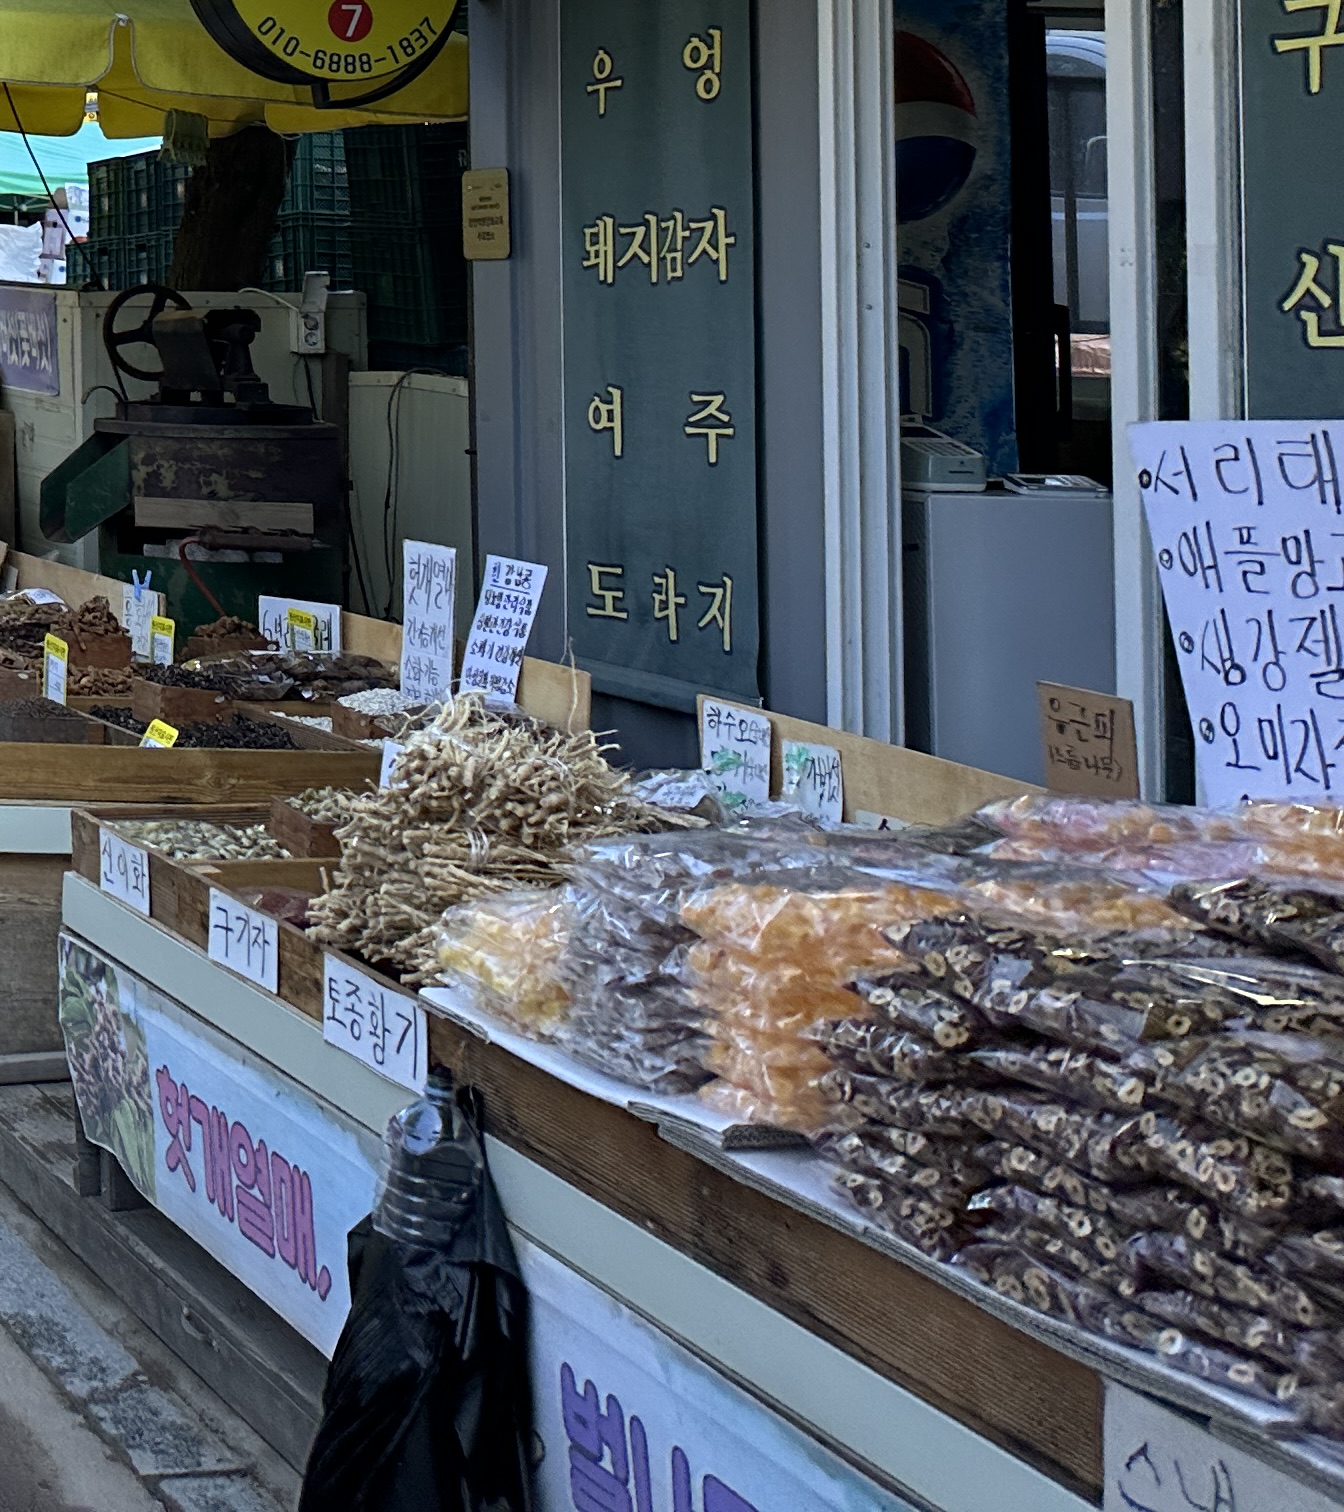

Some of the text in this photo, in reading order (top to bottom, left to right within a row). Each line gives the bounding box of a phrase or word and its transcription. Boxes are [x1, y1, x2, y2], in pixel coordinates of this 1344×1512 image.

[257, 16, 439, 74] 010-6888-1837
[341, 3, 363, 38] 7
[581, 207, 735, 284] 돼지감자
[1153, 428, 1343, 515] 서리태
[586, 561, 734, 653] 도라지
[706, 706, 758, 746] 하수오
[1219, 701, 1344, 790] 오미자
[212, 905, 271, 979] 구기자
[327, 976, 418, 1081] 토종황기
